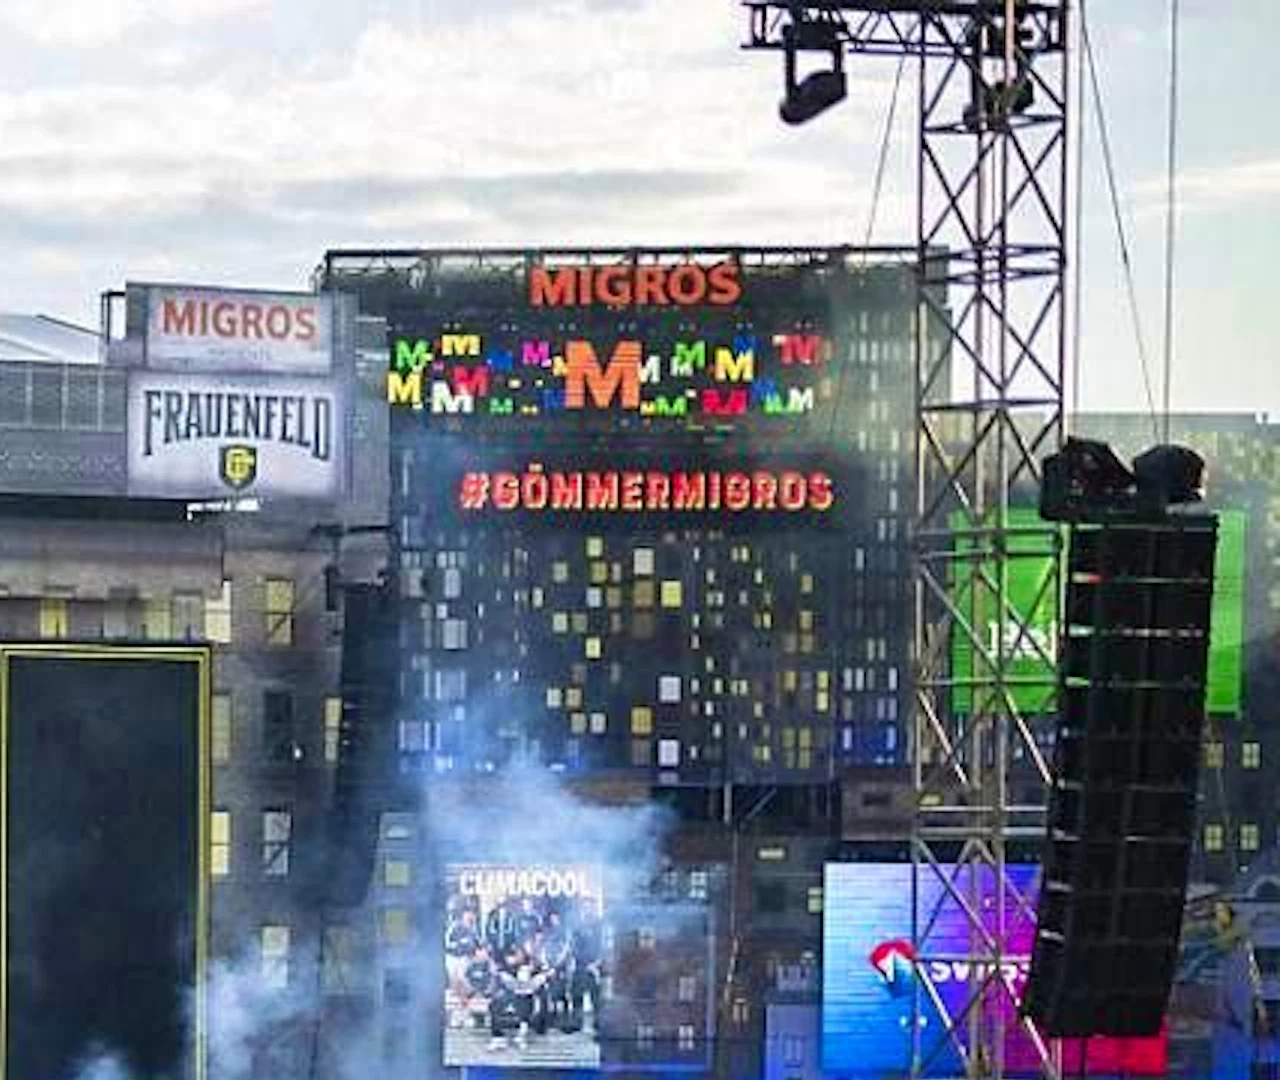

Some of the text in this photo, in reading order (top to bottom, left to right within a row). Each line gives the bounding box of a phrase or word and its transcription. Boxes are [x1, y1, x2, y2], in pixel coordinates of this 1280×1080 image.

[529, 264, 741, 306] MIGROS
[162, 300, 317, 340] MIGROS
[565, 340, 642, 409] M
[143, 390, 331, 461] FRAUENFELD
[459, 869, 592, 897] CLIMACOOL
